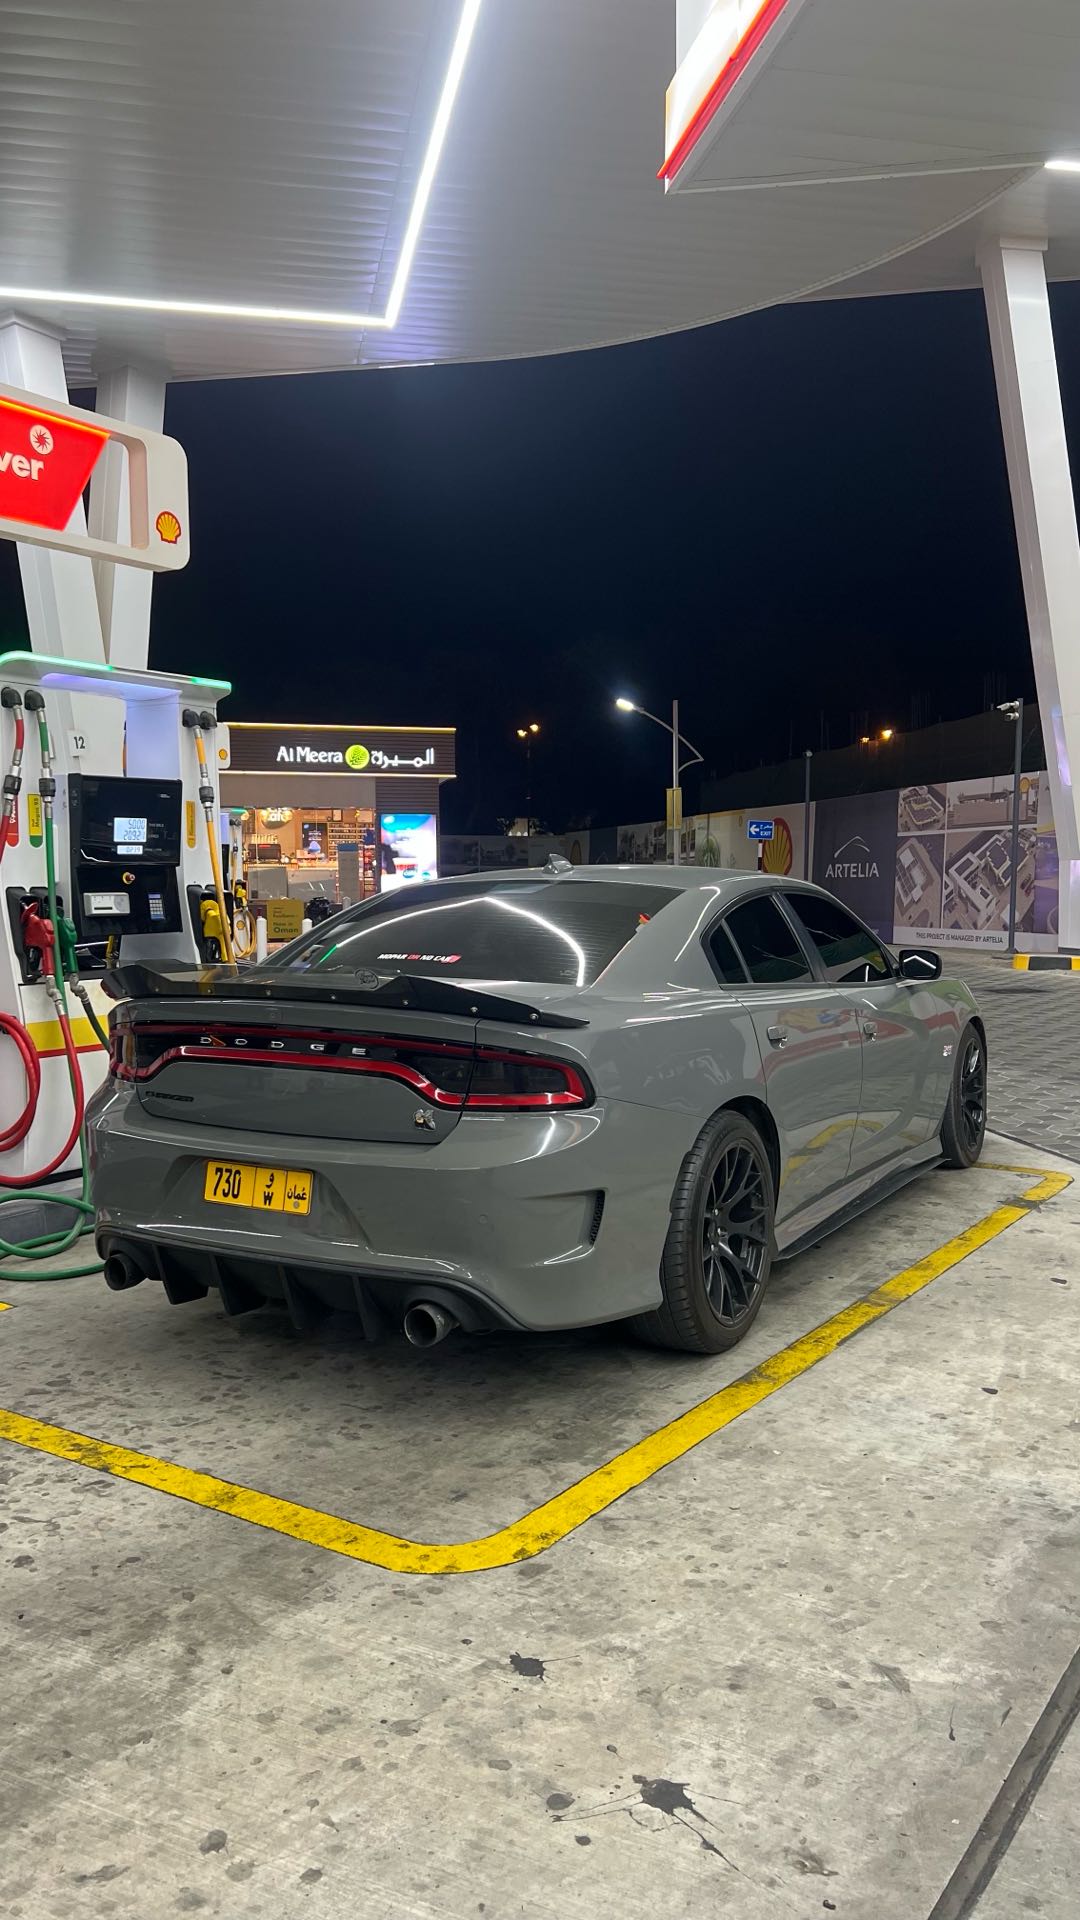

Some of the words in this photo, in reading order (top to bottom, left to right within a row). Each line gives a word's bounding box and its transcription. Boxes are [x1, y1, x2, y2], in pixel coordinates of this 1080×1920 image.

[73, 735, 86, 750] 12
[276, 745, 294, 762] Al
[296, 746, 343, 763] Meera
[824, 862, 880, 878] ARTELIA
[273, 926, 299, 934] Oman
[916, 931, 926, 940] THIS
[926, 932, 945, 941] PROJECT
[975, 935, 982, 943] BY
[199, 1036, 367, 1056] DODGE
[213, 1166, 242, 1199] 730
[264, 1172, 276, 1190] و
[263, 1190, 274, 1207] W
